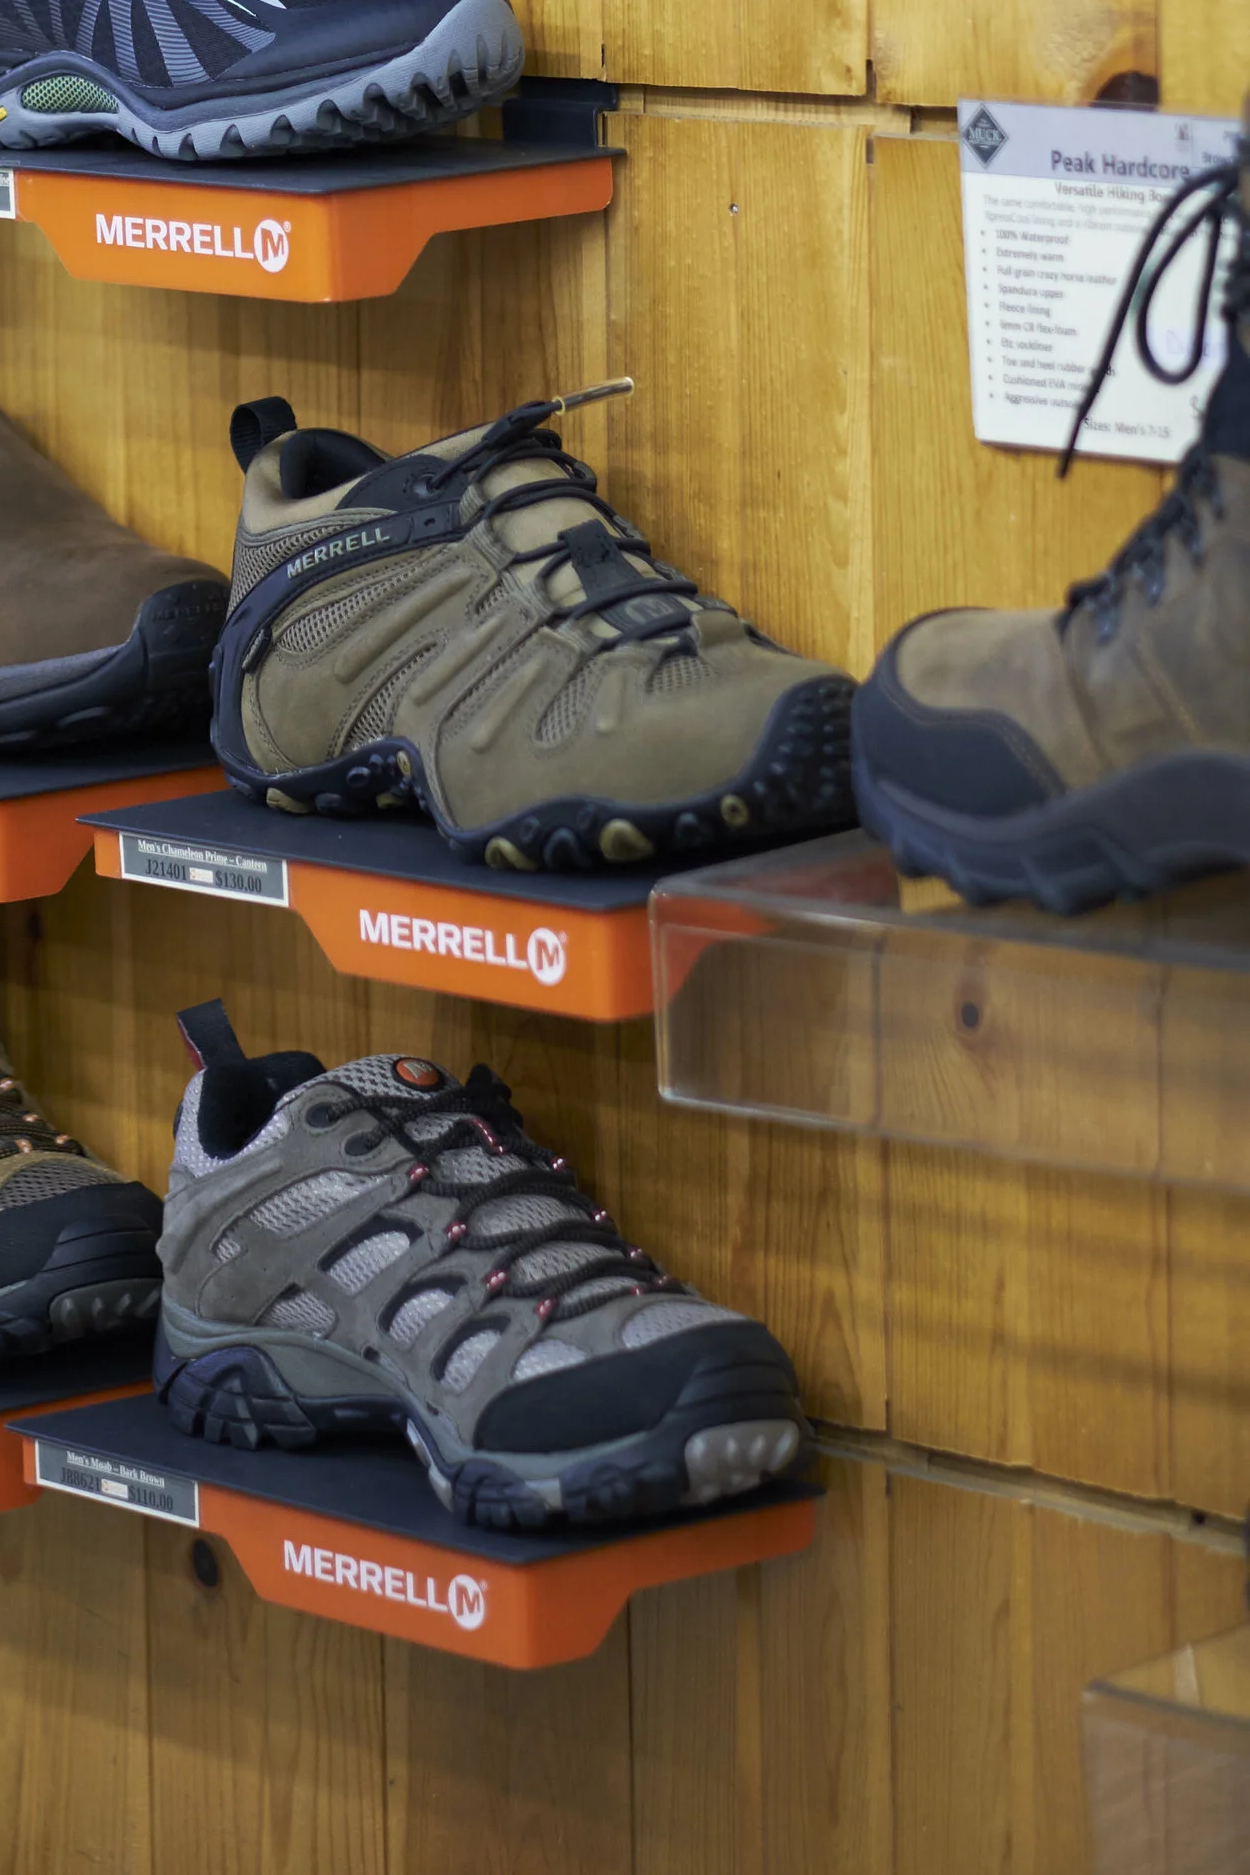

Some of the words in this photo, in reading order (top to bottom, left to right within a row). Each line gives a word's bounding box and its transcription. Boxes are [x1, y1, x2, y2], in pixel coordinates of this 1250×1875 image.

[968, 127, 1000, 142] MUCK
[1051, 149, 1095, 174] Peak
[1102, 153, 1191, 182] Hardcore
[1055, 182, 1104, 198] Versatile
[1108, 186, 1145, 204] Hiking
[96, 213, 254, 259] MERRELL
[1021, 231, 1070, 245] Waterproof
[996, 247, 1038, 262] Extremely
[1041, 253, 1064, 263] warm
[1040, 289, 1065, 300] upper
[999, 301, 1025, 314] Fleece
[1002, 356, 1017, 367] Toe
[1003, 374, 1047, 387] Cushioned
[1004, 391, 1048, 407] Aggressive
[1084, 418, 1111, 433] Sizes:
[1115, 422, 1145, 435] Men's
[287, 527, 390, 579] MERRELL
[138, 839, 161, 853] Men's
[162, 843, 203, 861] Chameleon
[205, 850, 227, 864] Prime
[145, 859, 187, 881] J21401
[215, 870, 262, 893] $130.00
[359, 908, 528, 970] MERRELL
[67, 1451, 89, 1465] Men's
[91, 1457, 112, 1472] Moab
[120, 1465, 138, 1480] Bark
[140, 1470, 165, 1487] Brown
[61, 1467, 100, 1491] J88621
[129, 1485, 174, 1511] $110.00
[283, 1539, 448, 1613] MERRELL
